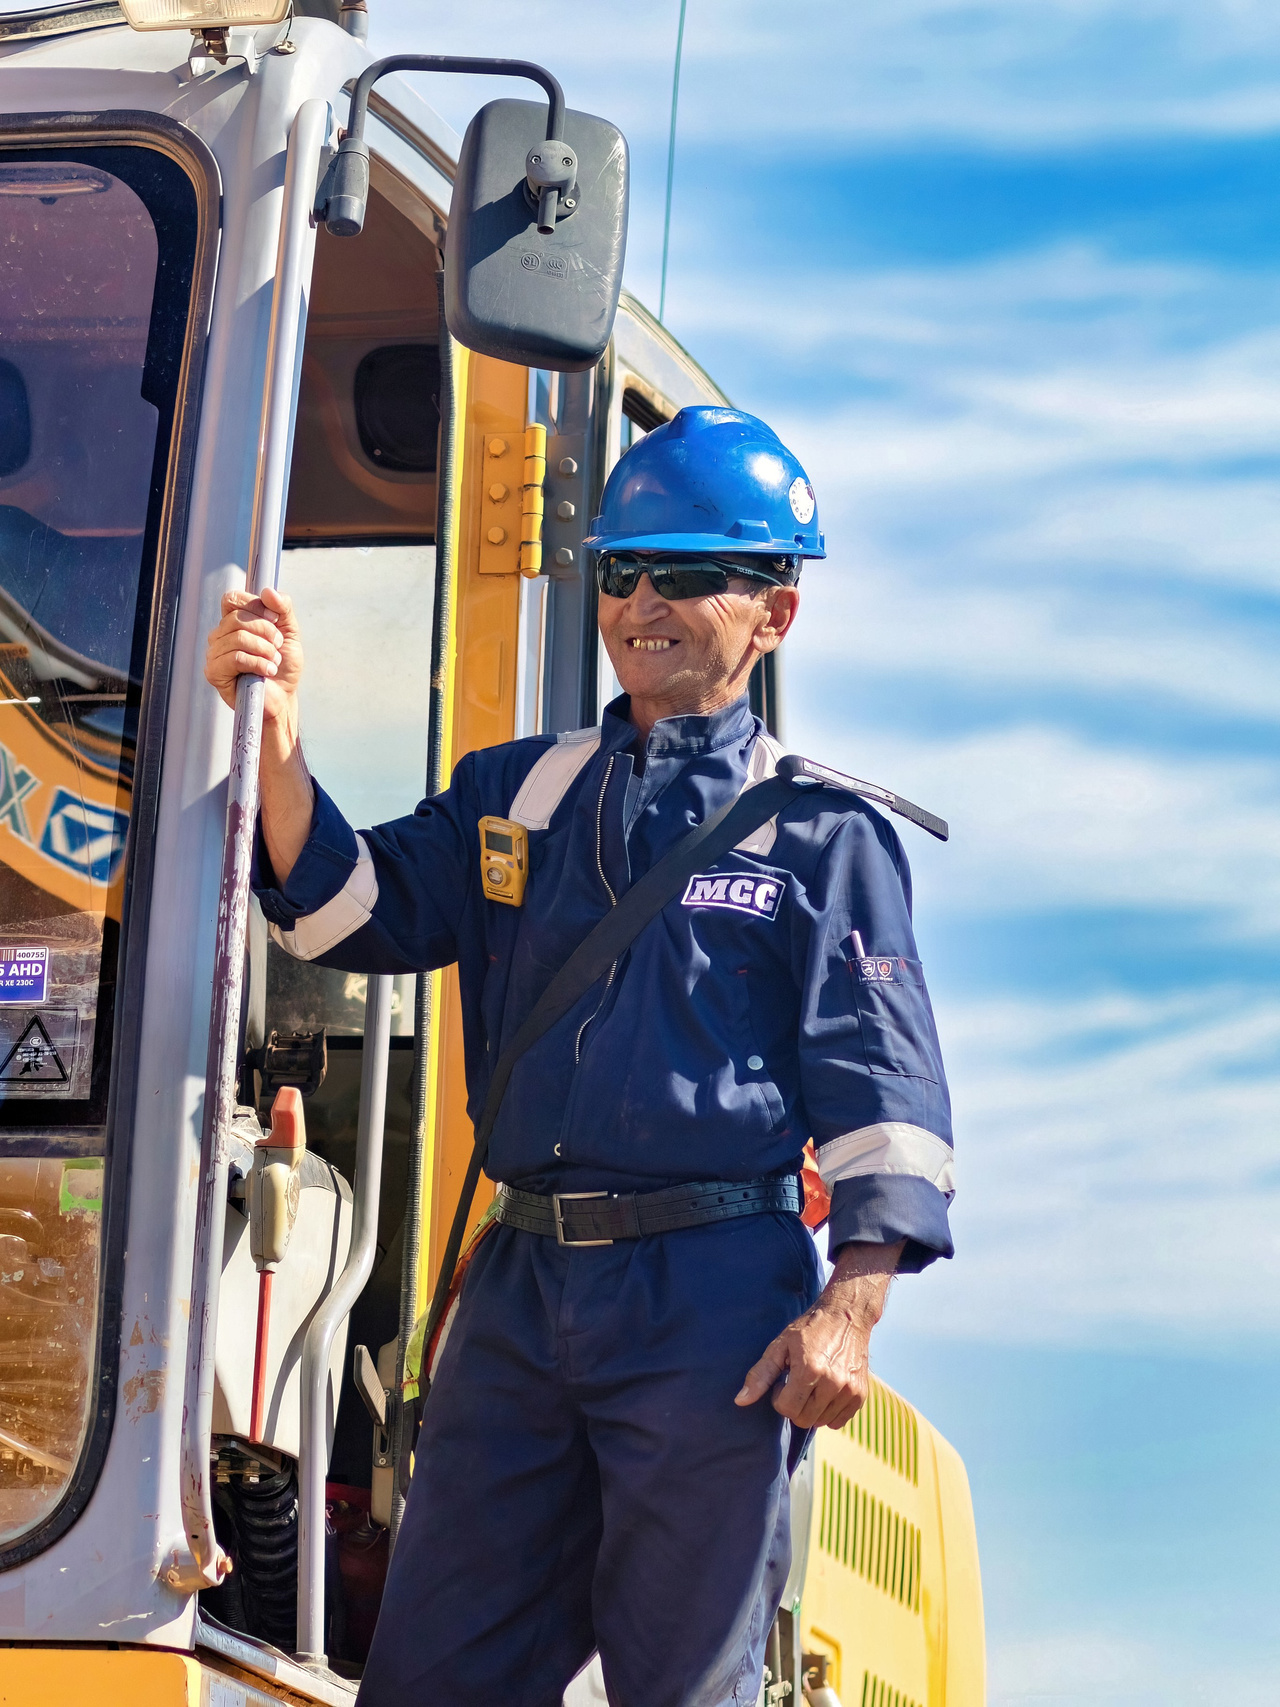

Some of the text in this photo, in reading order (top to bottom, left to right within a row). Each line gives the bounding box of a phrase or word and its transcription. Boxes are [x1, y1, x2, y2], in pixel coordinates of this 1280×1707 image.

[690, 879, 778, 912] MCC
[8, 963, 43, 976] AHD
[5, 979, 15, 987] XE
